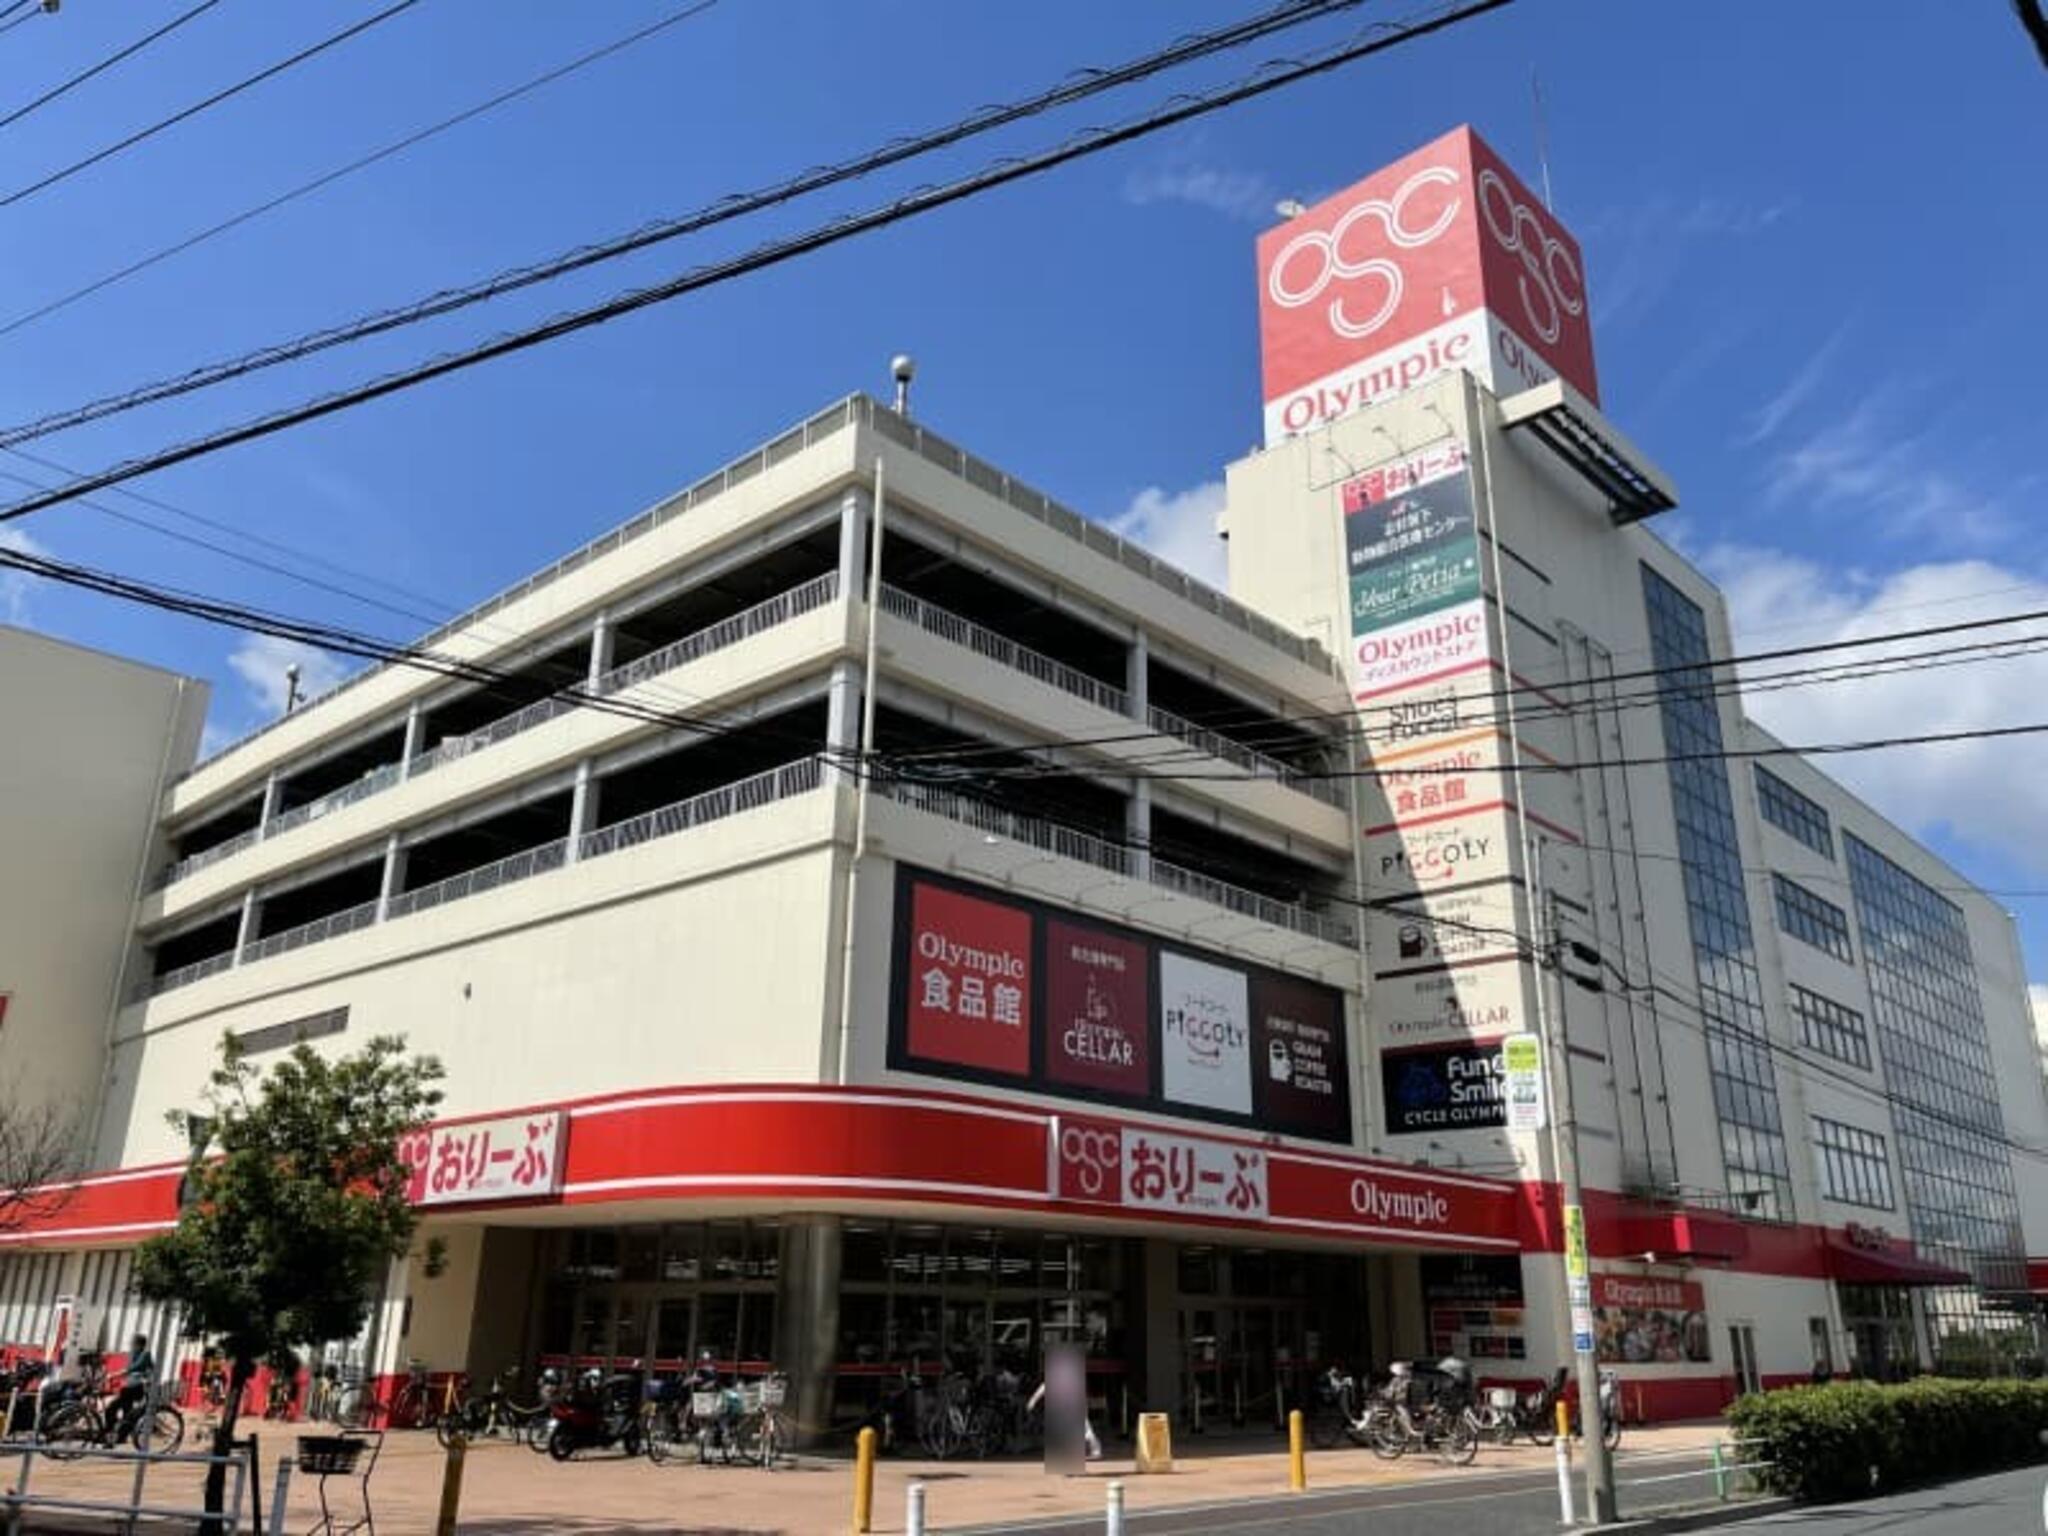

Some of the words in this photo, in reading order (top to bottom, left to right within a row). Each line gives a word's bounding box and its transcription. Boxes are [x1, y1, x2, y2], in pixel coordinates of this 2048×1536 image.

[1282, 331, 1471, 433] Olympic
[1357, 613, 1482, 665] Olympic
[917, 931, 1025, 980] Olympic
[921, 967, 1023, 1027] 食品館
[1063, 1030, 1134, 1066] CELLAR
[431, 1116, 554, 1195] おりーぶ
[1129, 1137, 1261, 1212] おりーぶ
[1350, 1179, 1449, 1225] Olympic
